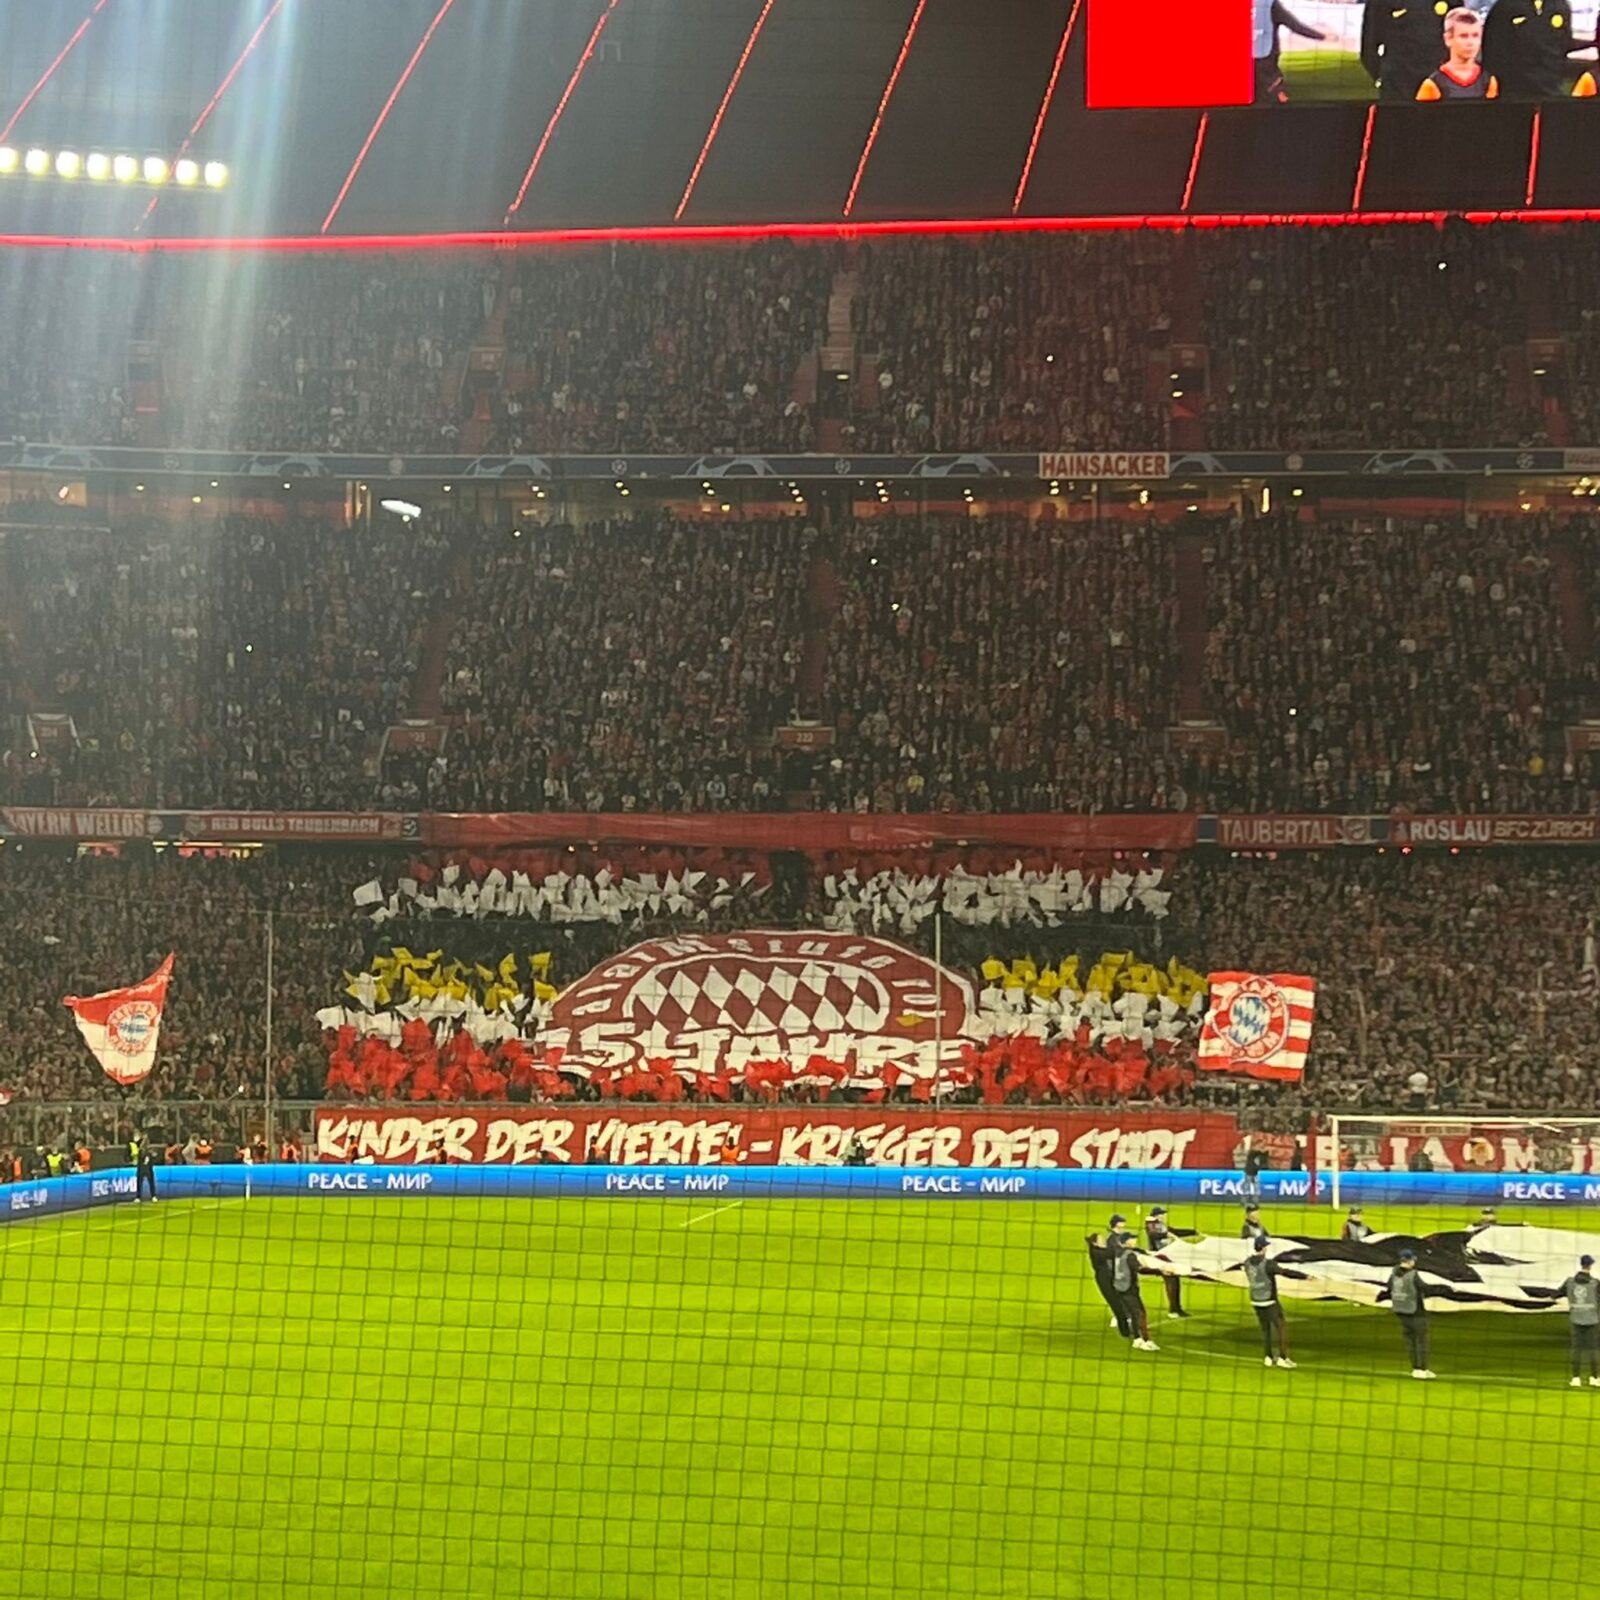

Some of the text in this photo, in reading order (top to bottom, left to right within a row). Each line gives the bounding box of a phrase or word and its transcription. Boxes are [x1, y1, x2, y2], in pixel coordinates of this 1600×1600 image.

[1042, 455, 1167, 476] HAINSACKER
[796, 732, 814, 743] 222
[75, 813, 145, 836] WELLOS
[211, 816, 239, 831] RED
[1221, 820, 1335, 843] TAUBERTAL
[1410, 818, 1491, 842] RÖSLAU
[1530, 818, 1595, 838] ZÜRICH
[630, 1024, 975, 1082] JAHRE
[317, 1116, 478, 1164] KINDER
[483, 1118, 575, 1164] DER
[777, 1122, 962, 1167] KRIEGER
[970, 1125, 1060, 1169] DER
[1069, 1128, 1197, 1170] STADT
[308, 1173, 368, 1190] PEACE
[606, 1173, 665, 1191] PEACE
[902, 1176, 962, 1193] PEACE
[1503, 1182, 1566, 1199] PEACE
